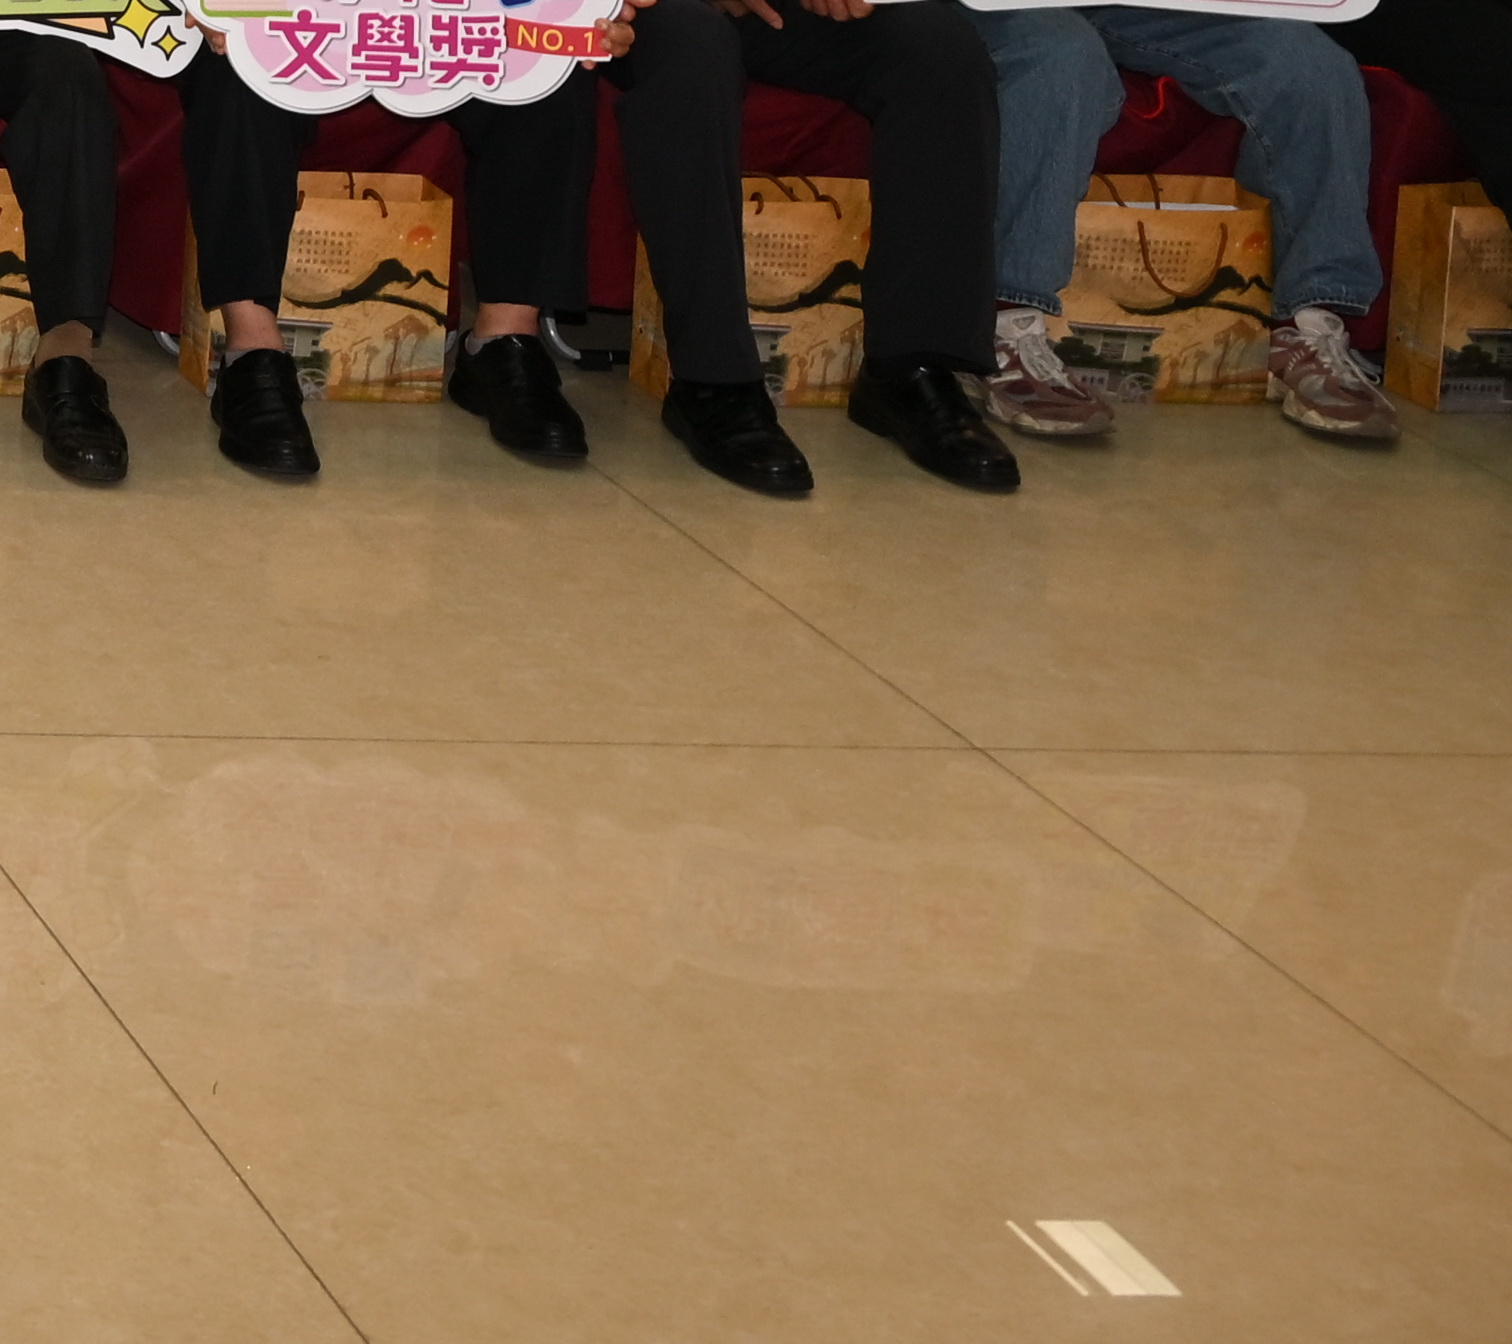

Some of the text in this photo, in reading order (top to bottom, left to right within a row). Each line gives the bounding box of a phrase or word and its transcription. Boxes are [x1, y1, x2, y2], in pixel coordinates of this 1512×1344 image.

[268, 13, 507, 90] 文學獎
[517, 23, 593, 54] NO.1
